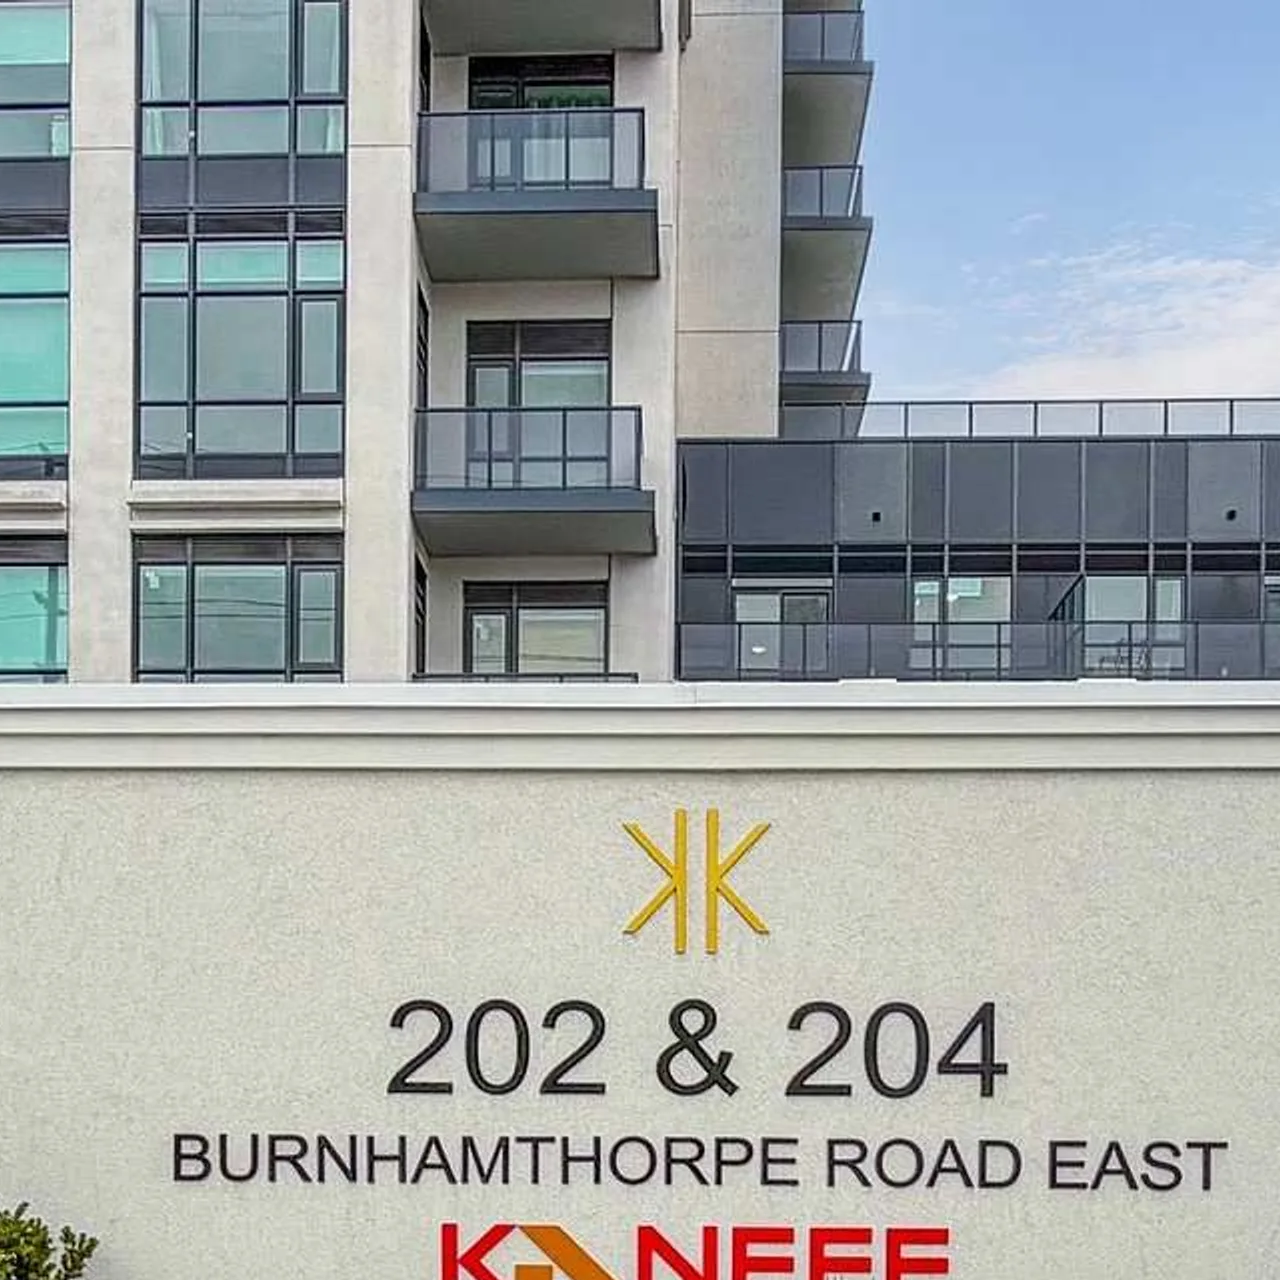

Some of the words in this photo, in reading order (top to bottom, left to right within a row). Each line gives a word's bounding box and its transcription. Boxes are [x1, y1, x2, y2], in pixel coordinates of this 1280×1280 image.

[386, 999, 606, 1096] 202
[655, 999, 740, 1097] &
[784, 1001, 1009, 1099] 204
[173, 1133, 800, 1188] BURNHAMTHORPE
[827, 1138, 1022, 1190] ROAD
[1048, 1140, 1229, 1192] EAST
